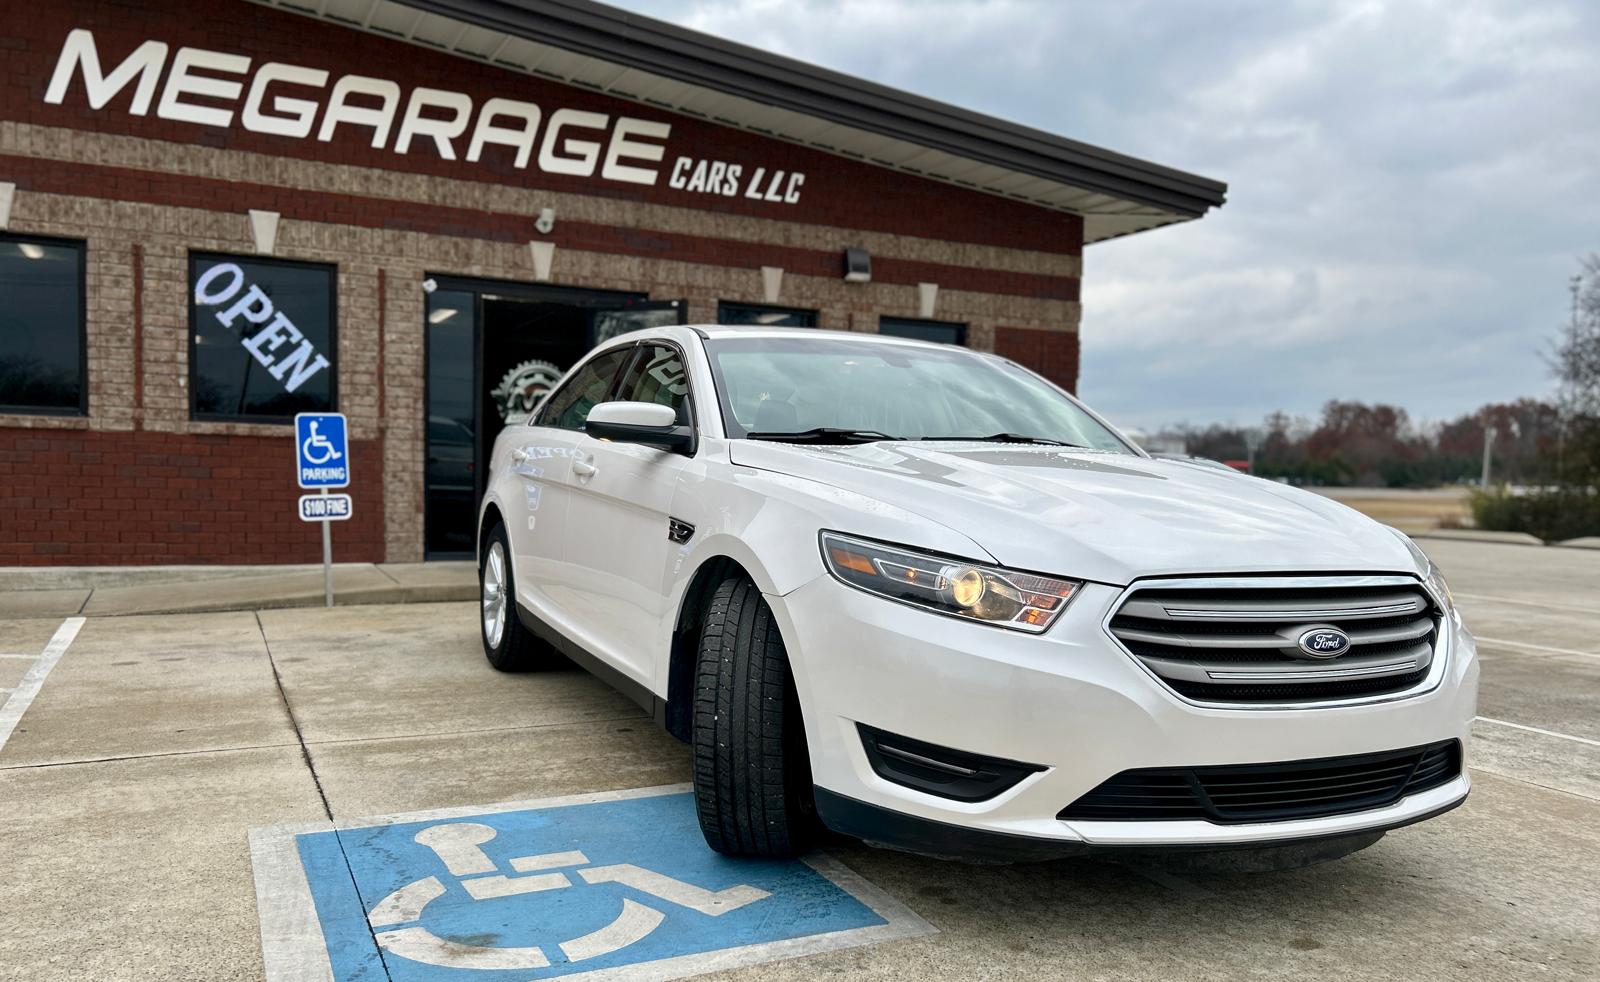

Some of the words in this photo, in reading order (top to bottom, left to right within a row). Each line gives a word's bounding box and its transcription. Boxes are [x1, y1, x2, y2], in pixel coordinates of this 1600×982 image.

[44, 29, 671, 186] MEGARAGE
[669, 156, 742, 196] CARS
[745, 168, 805, 203] LLC
[195, 262, 331, 393] OPEN
[302, 467, 345, 480] PARKING
[327, 499, 347, 514] FINE
[1314, 634, 1340, 649] Ford
